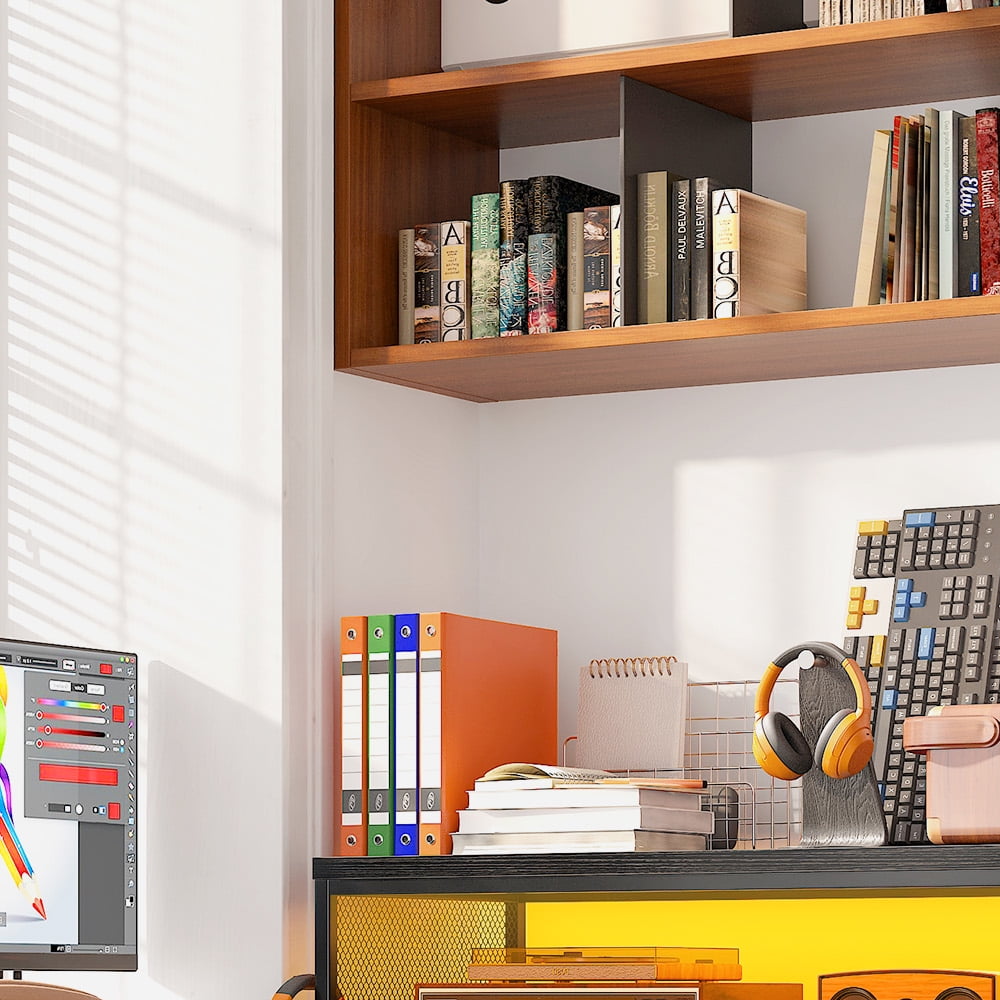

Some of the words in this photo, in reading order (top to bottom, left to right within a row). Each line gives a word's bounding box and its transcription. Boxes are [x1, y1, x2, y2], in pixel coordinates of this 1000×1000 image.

[677, 190, 687, 234] DELVAUX
[959, 176, 979, 217] Elvis
[695, 190, 705, 249] MALEVITCH
[677, 236, 686, 260] PAUL
